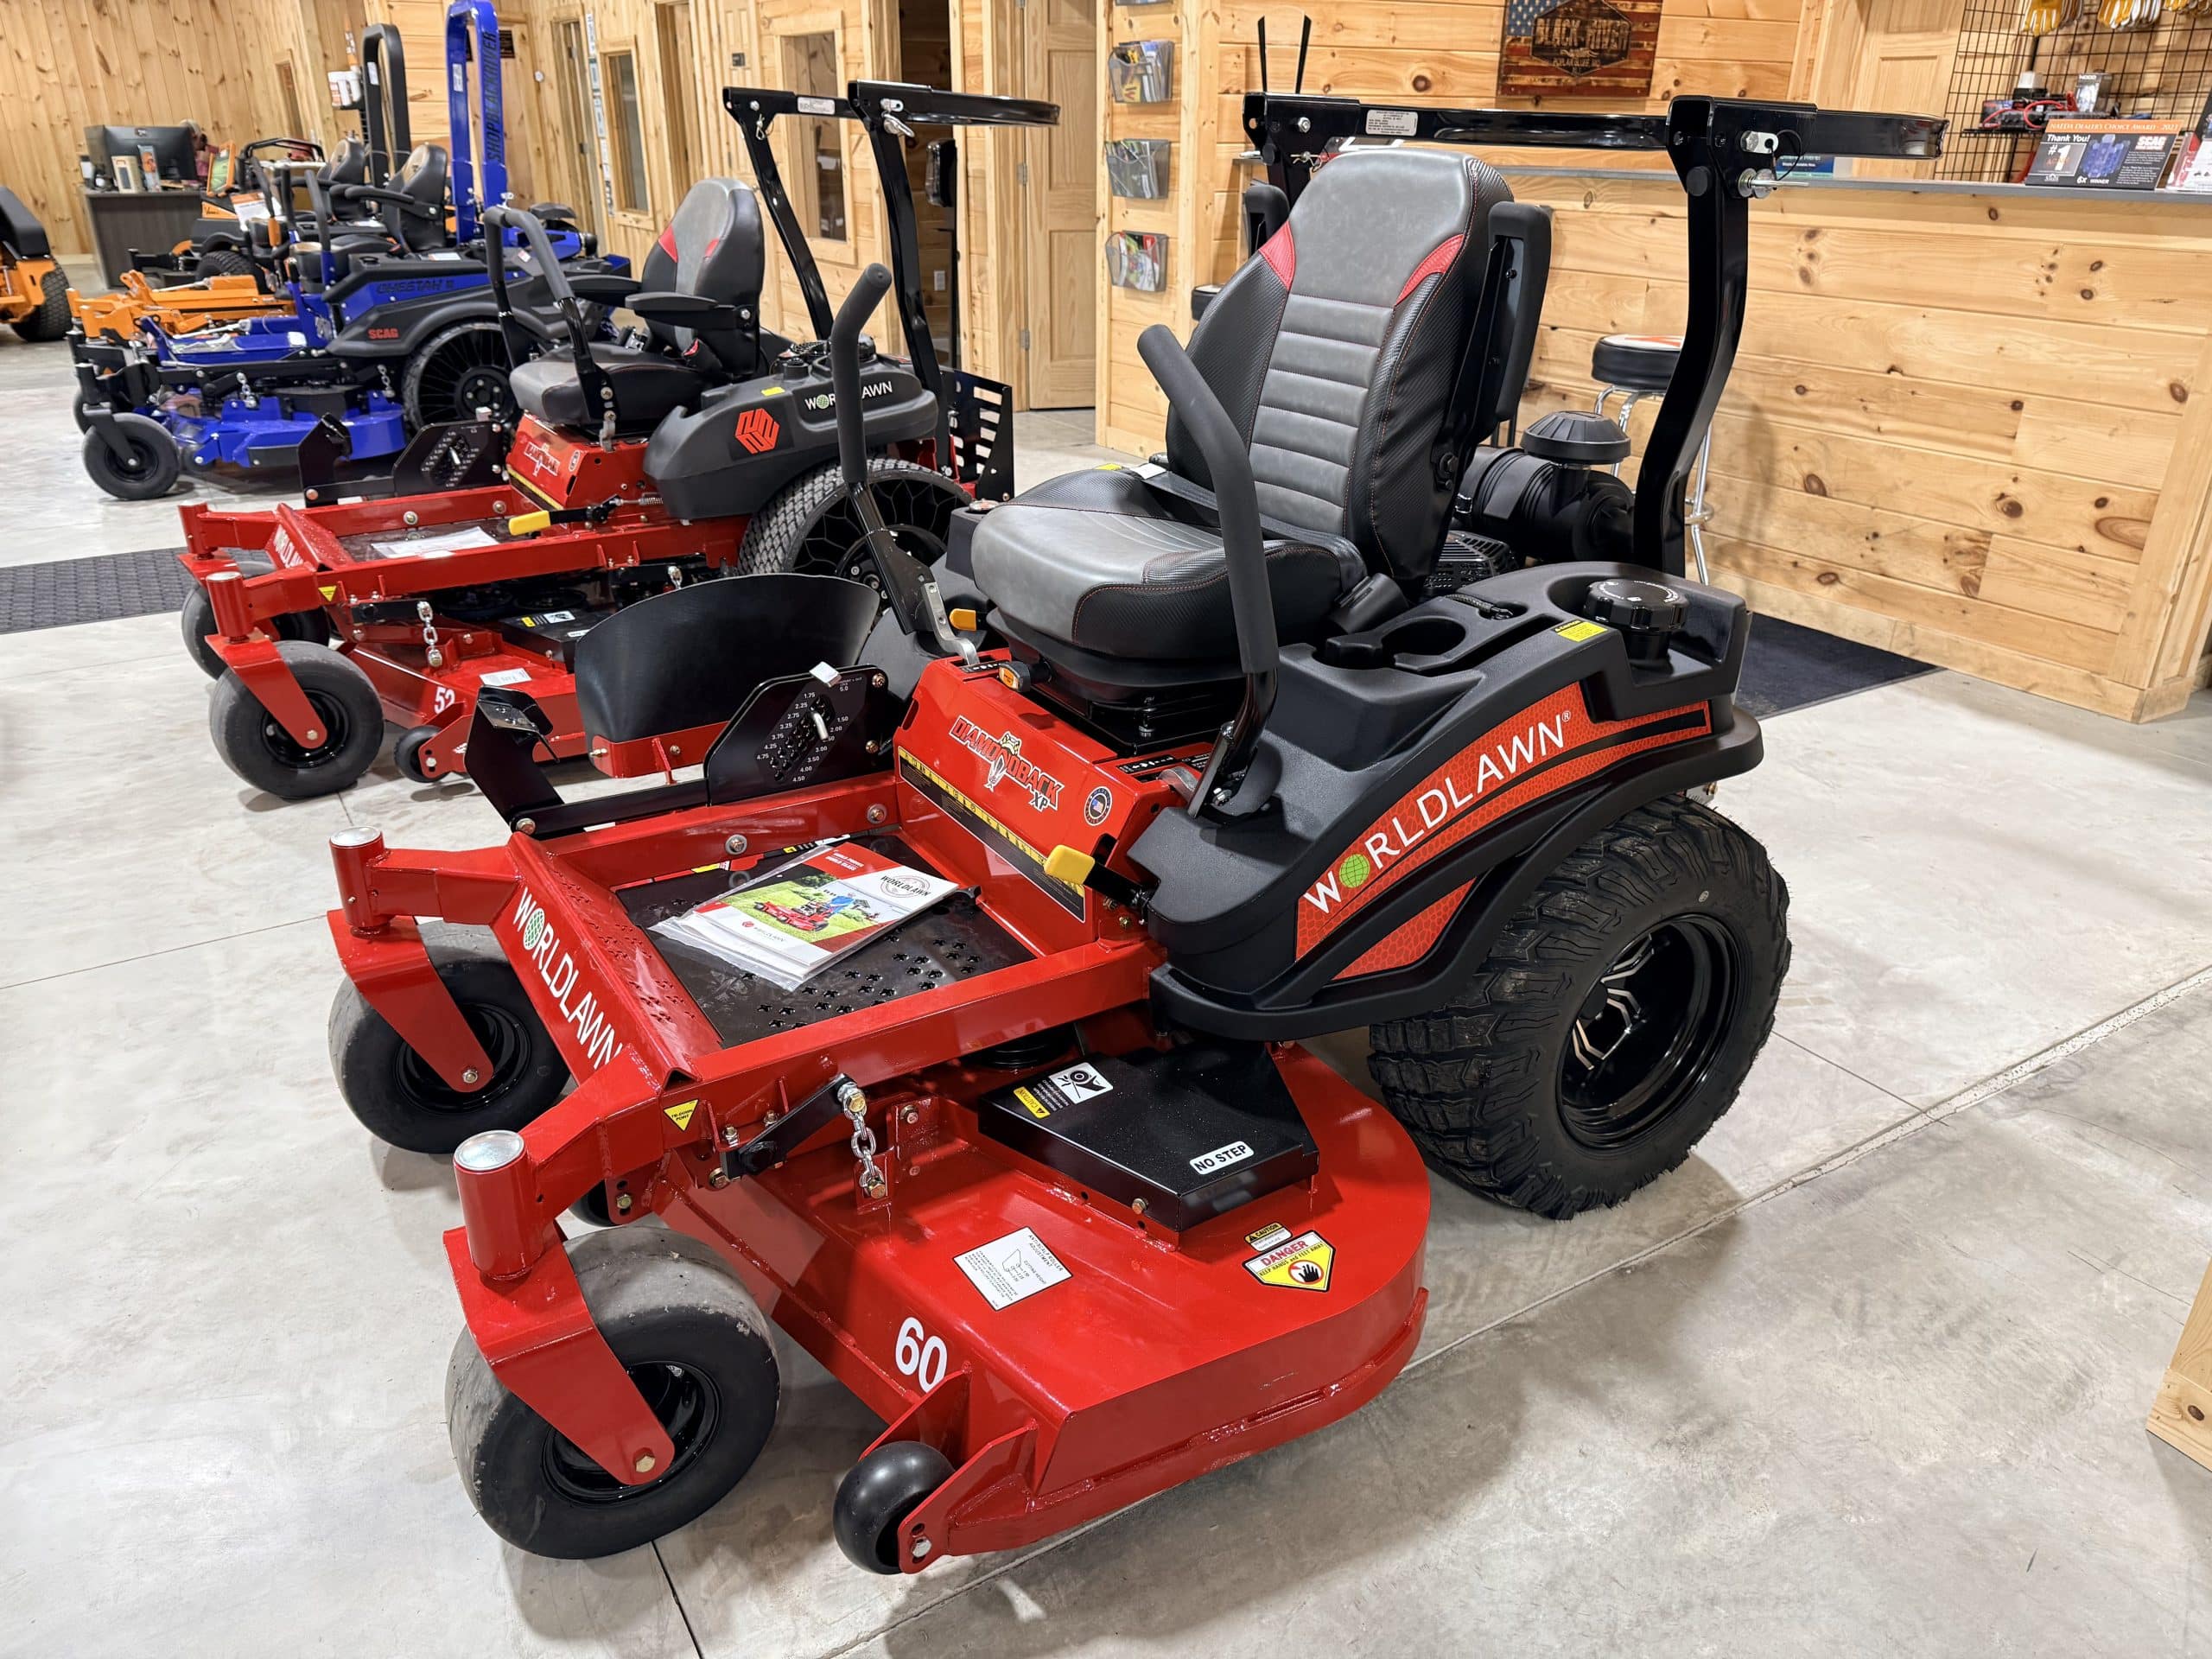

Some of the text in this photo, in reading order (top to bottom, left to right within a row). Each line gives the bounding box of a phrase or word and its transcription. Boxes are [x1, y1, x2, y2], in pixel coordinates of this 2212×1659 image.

[367, 327, 399, 340] SCAG
[434, 685, 455, 715] 52
[950, 716, 1064, 809] DIAMONDBACK
[1030, 792, 1049, 810] XP
[880, 875, 931, 897] WORLDLAWN
[1193, 1144, 1246, 1171] NO STEP
[1255, 1223, 1279, 1237] CAUTION
[1260, 1240, 1309, 1266] DANGER
[895, 1316, 948, 1393] 60
